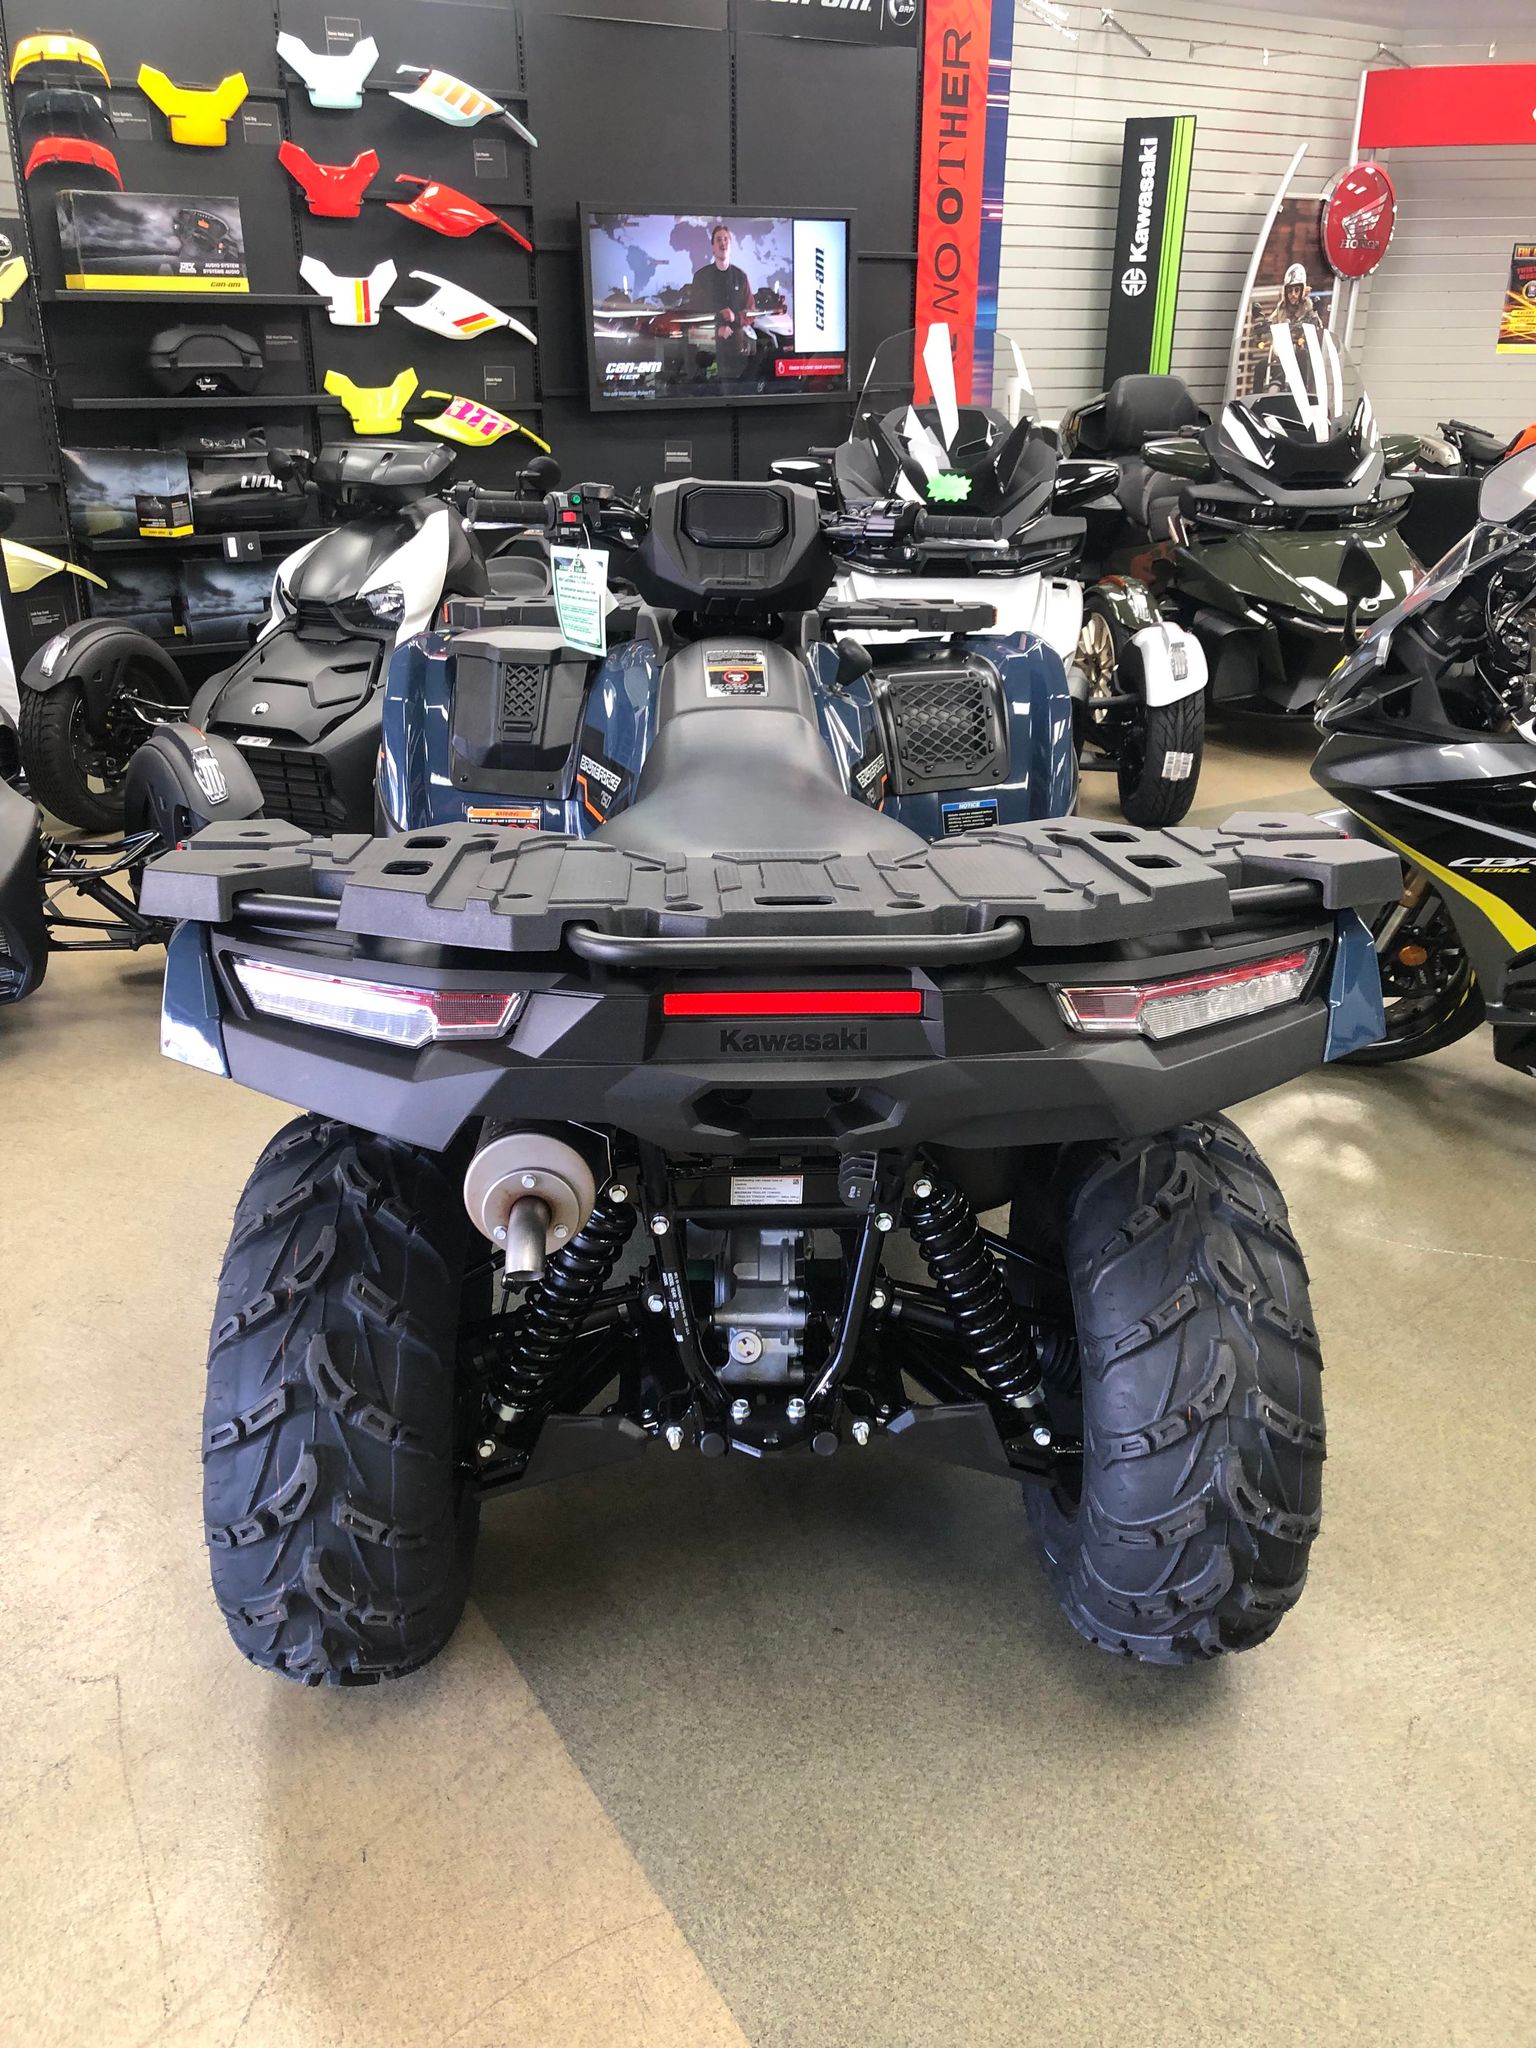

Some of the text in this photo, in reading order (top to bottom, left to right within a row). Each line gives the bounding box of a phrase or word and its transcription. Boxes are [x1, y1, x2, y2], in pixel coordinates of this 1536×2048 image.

[899, 5, 914, 13] BRP
[936, 28, 972, 225] OTHER
[1129, 137, 1158, 263] Kawasaki
[815, 247, 825, 331] can-am
[605, 361, 663, 374] can-am
[959, 801, 981, 810] NOTICE
[719, 1027, 869, 1052] Kawasaki
